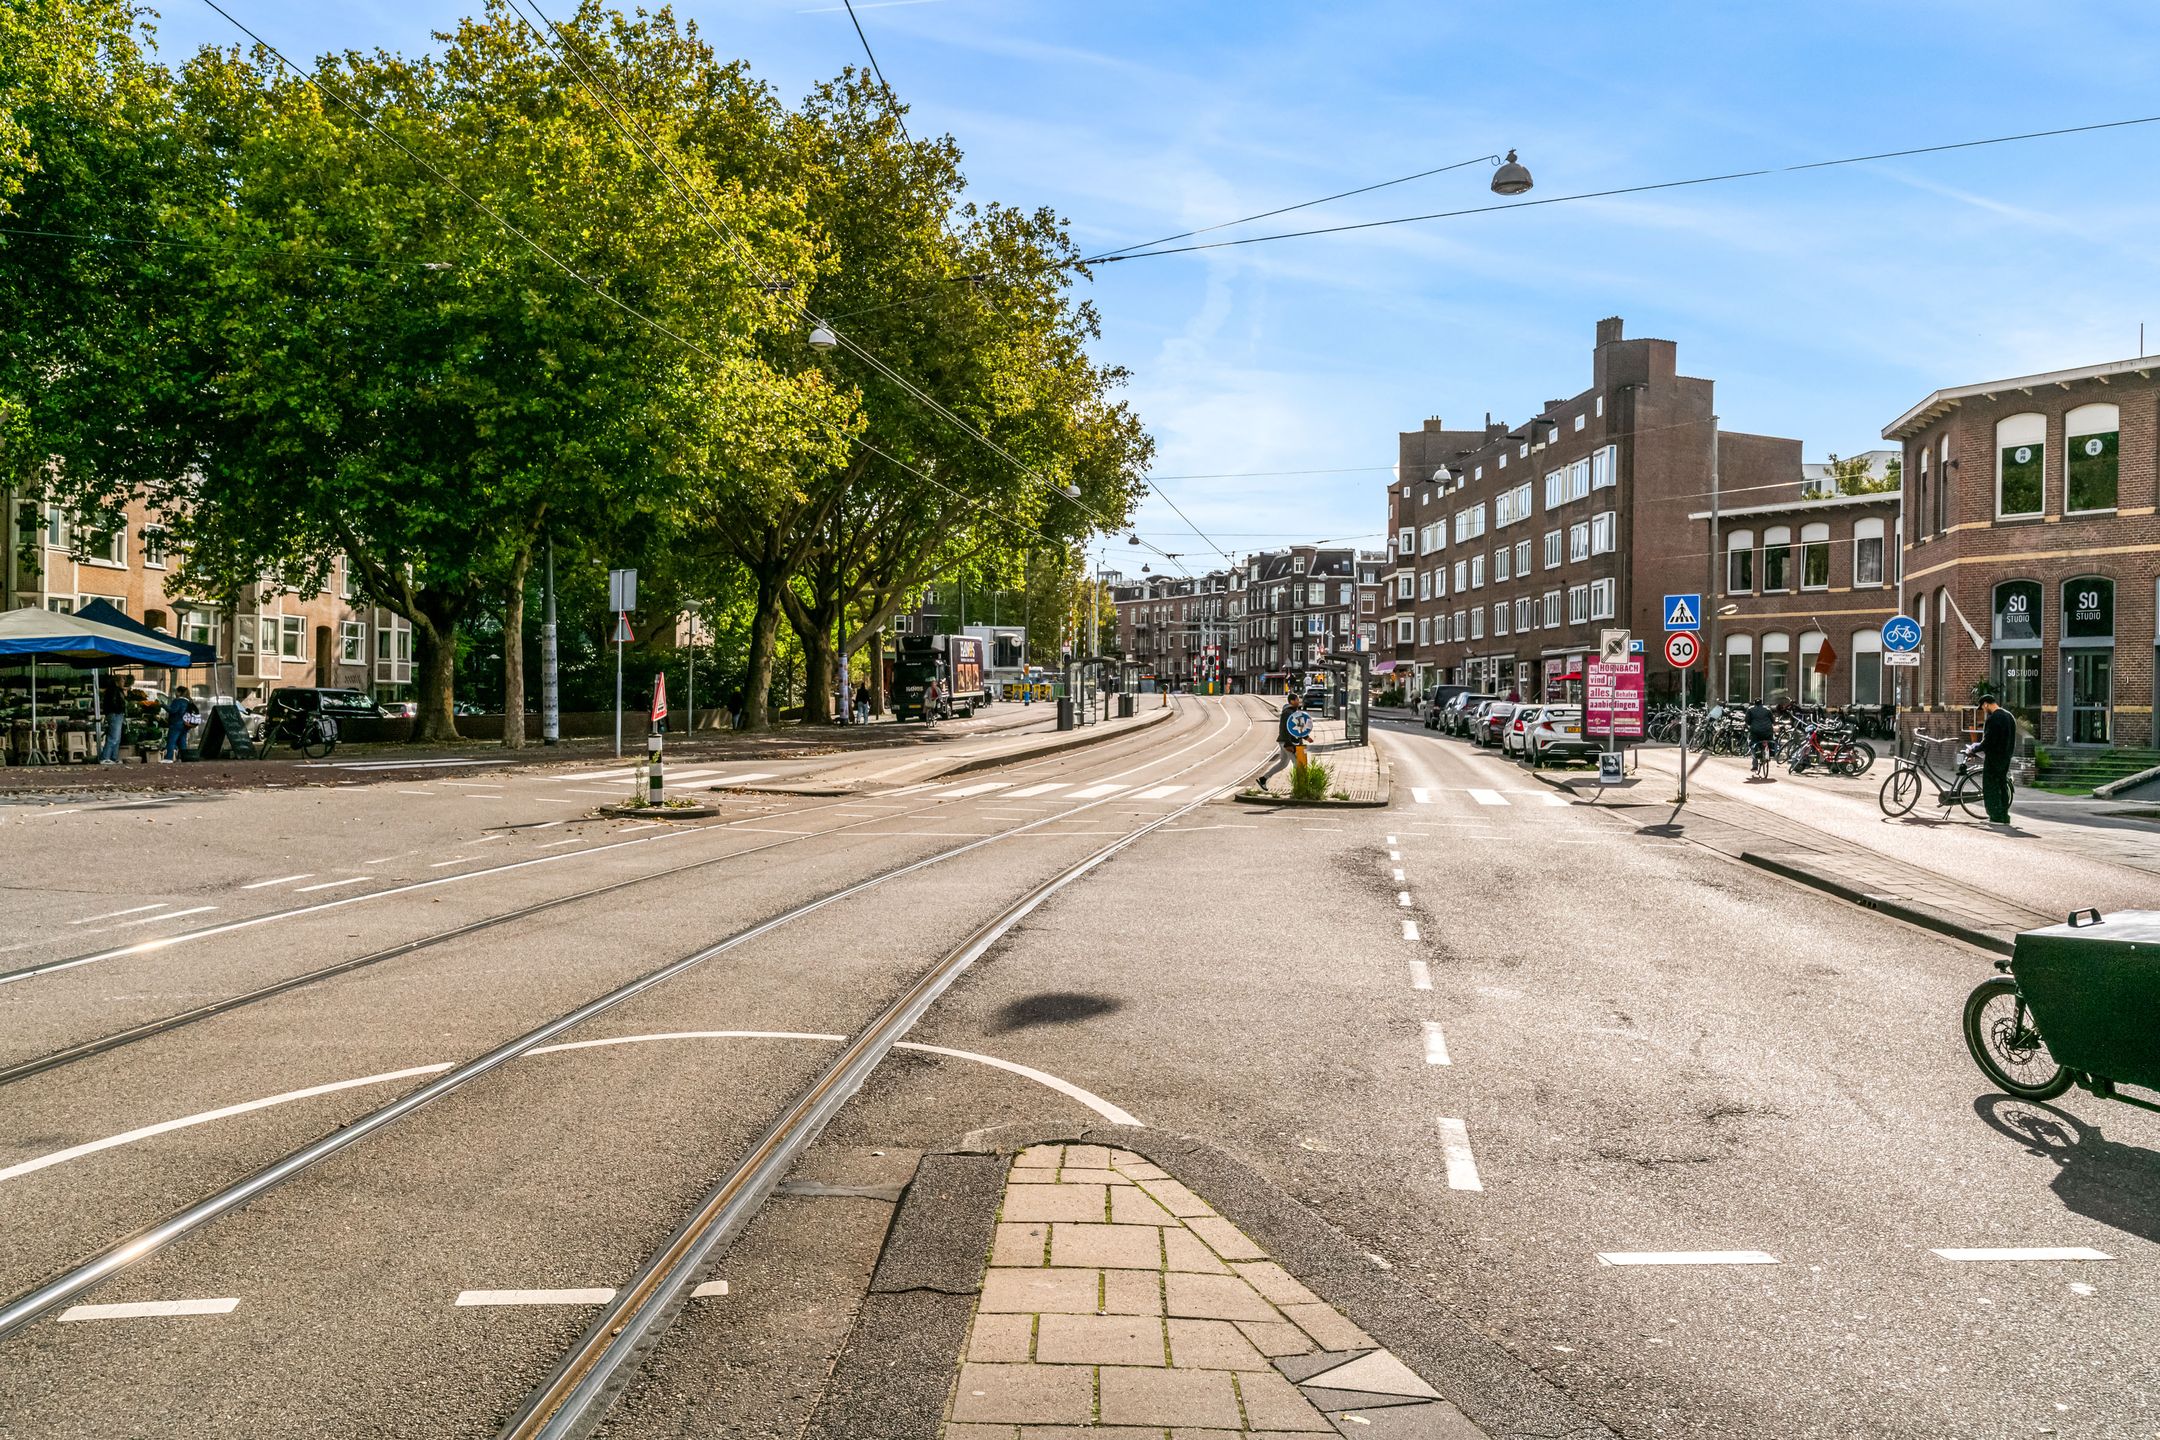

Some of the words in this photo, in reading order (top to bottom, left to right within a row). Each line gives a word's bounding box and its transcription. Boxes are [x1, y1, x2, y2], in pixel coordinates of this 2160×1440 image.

[2009, 595, 2027, 612] SO
[2079, 592, 2098, 609] SO
[2006, 615, 2030, 623] STUDIO
[2076, 612, 2101, 620] STUDIO
[1672, 643, 1693, 656] 30
[1600, 664, 1639, 672] HORNBACH
[2007, 669, 2016, 677] SO
[2016, 669, 2039, 677] STUDIO
[1590, 675, 1606, 683] vind
[1590, 688, 1613, 697] alles.
